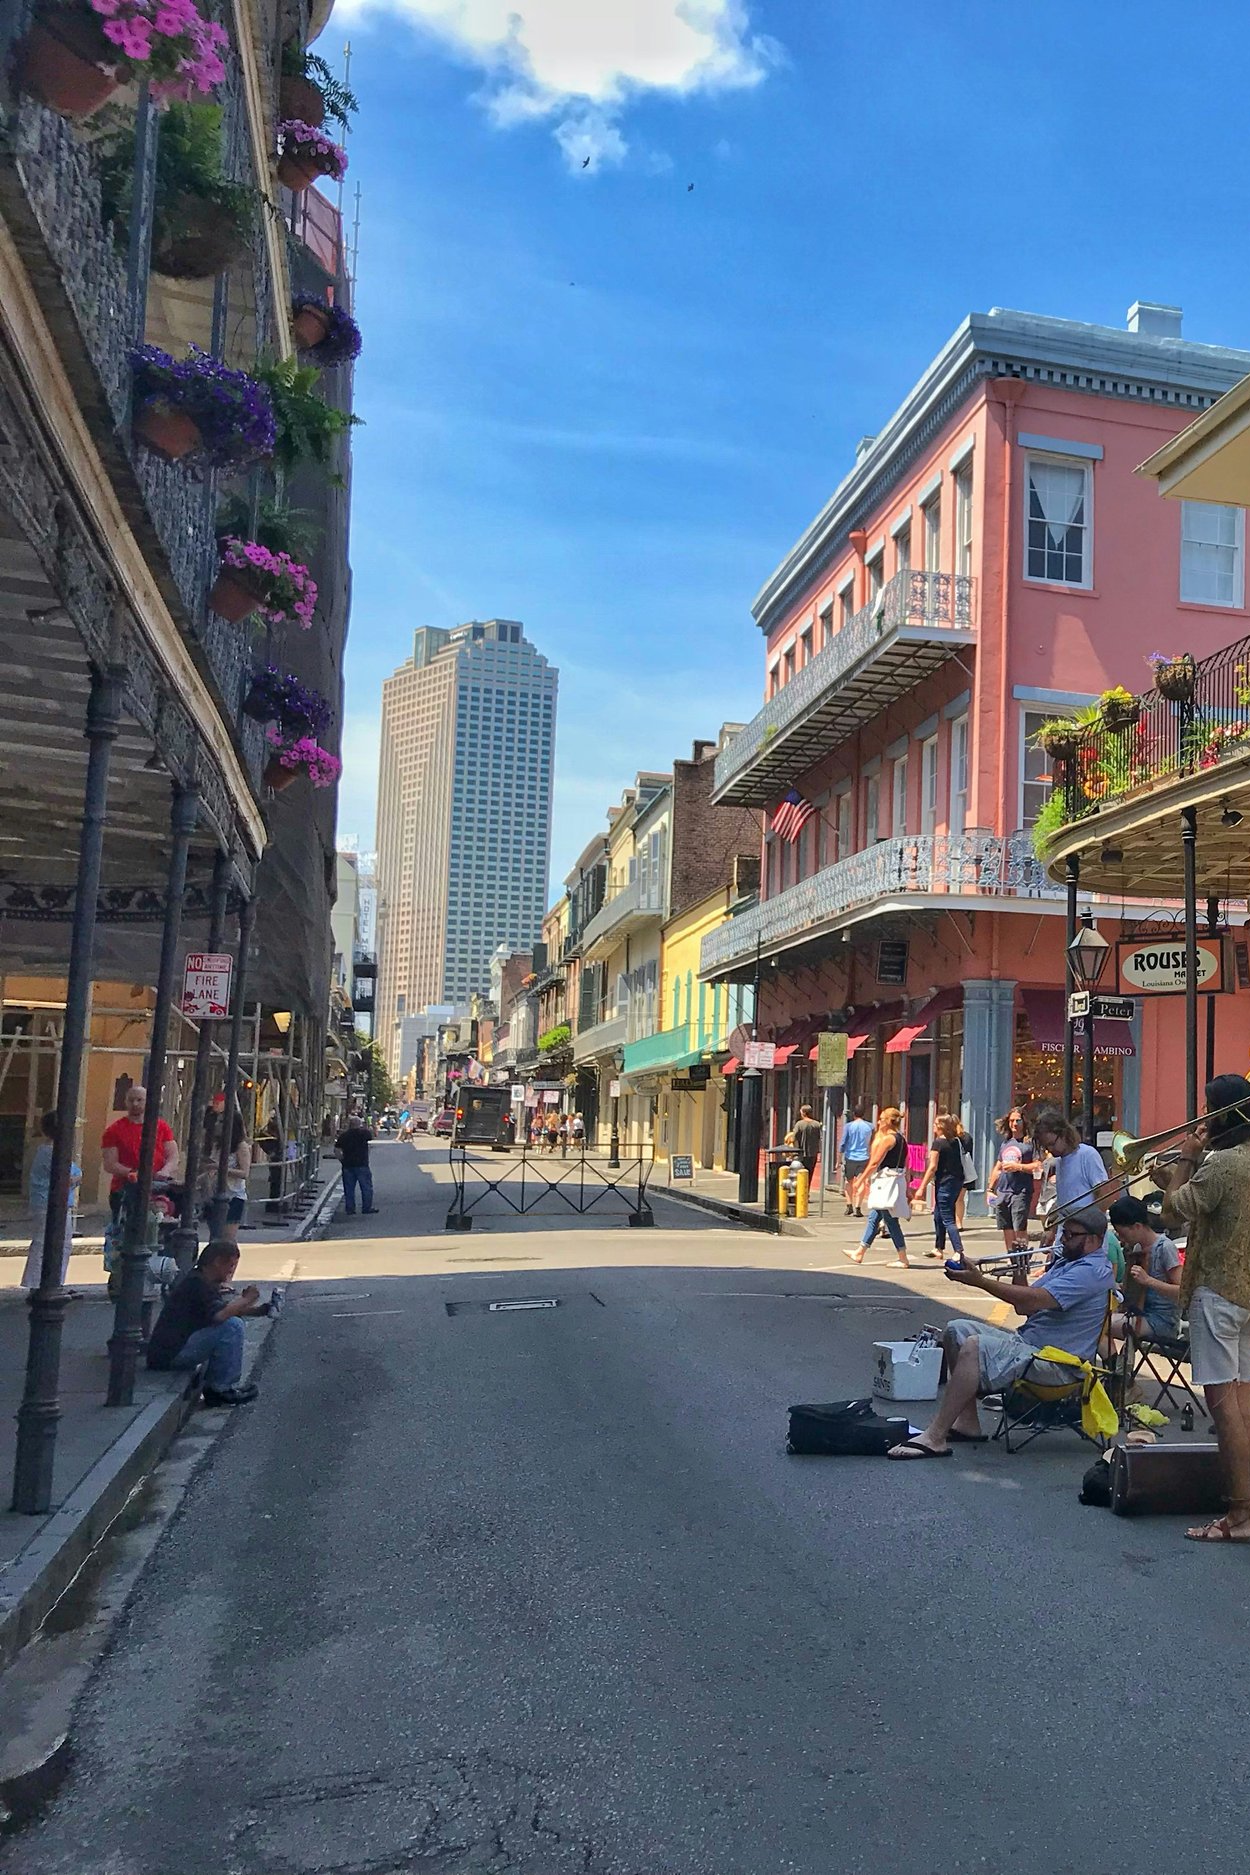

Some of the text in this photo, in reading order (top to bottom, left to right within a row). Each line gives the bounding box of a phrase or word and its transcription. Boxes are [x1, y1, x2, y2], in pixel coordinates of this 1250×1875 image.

[187, 956, 202, 970] NO
[195, 975, 219, 986] FIRE
[1142, 980, 1173, 988] Louisiana
[193, 988, 220, 1000] LANE
[1100, 1003, 1131, 1016] Peter
